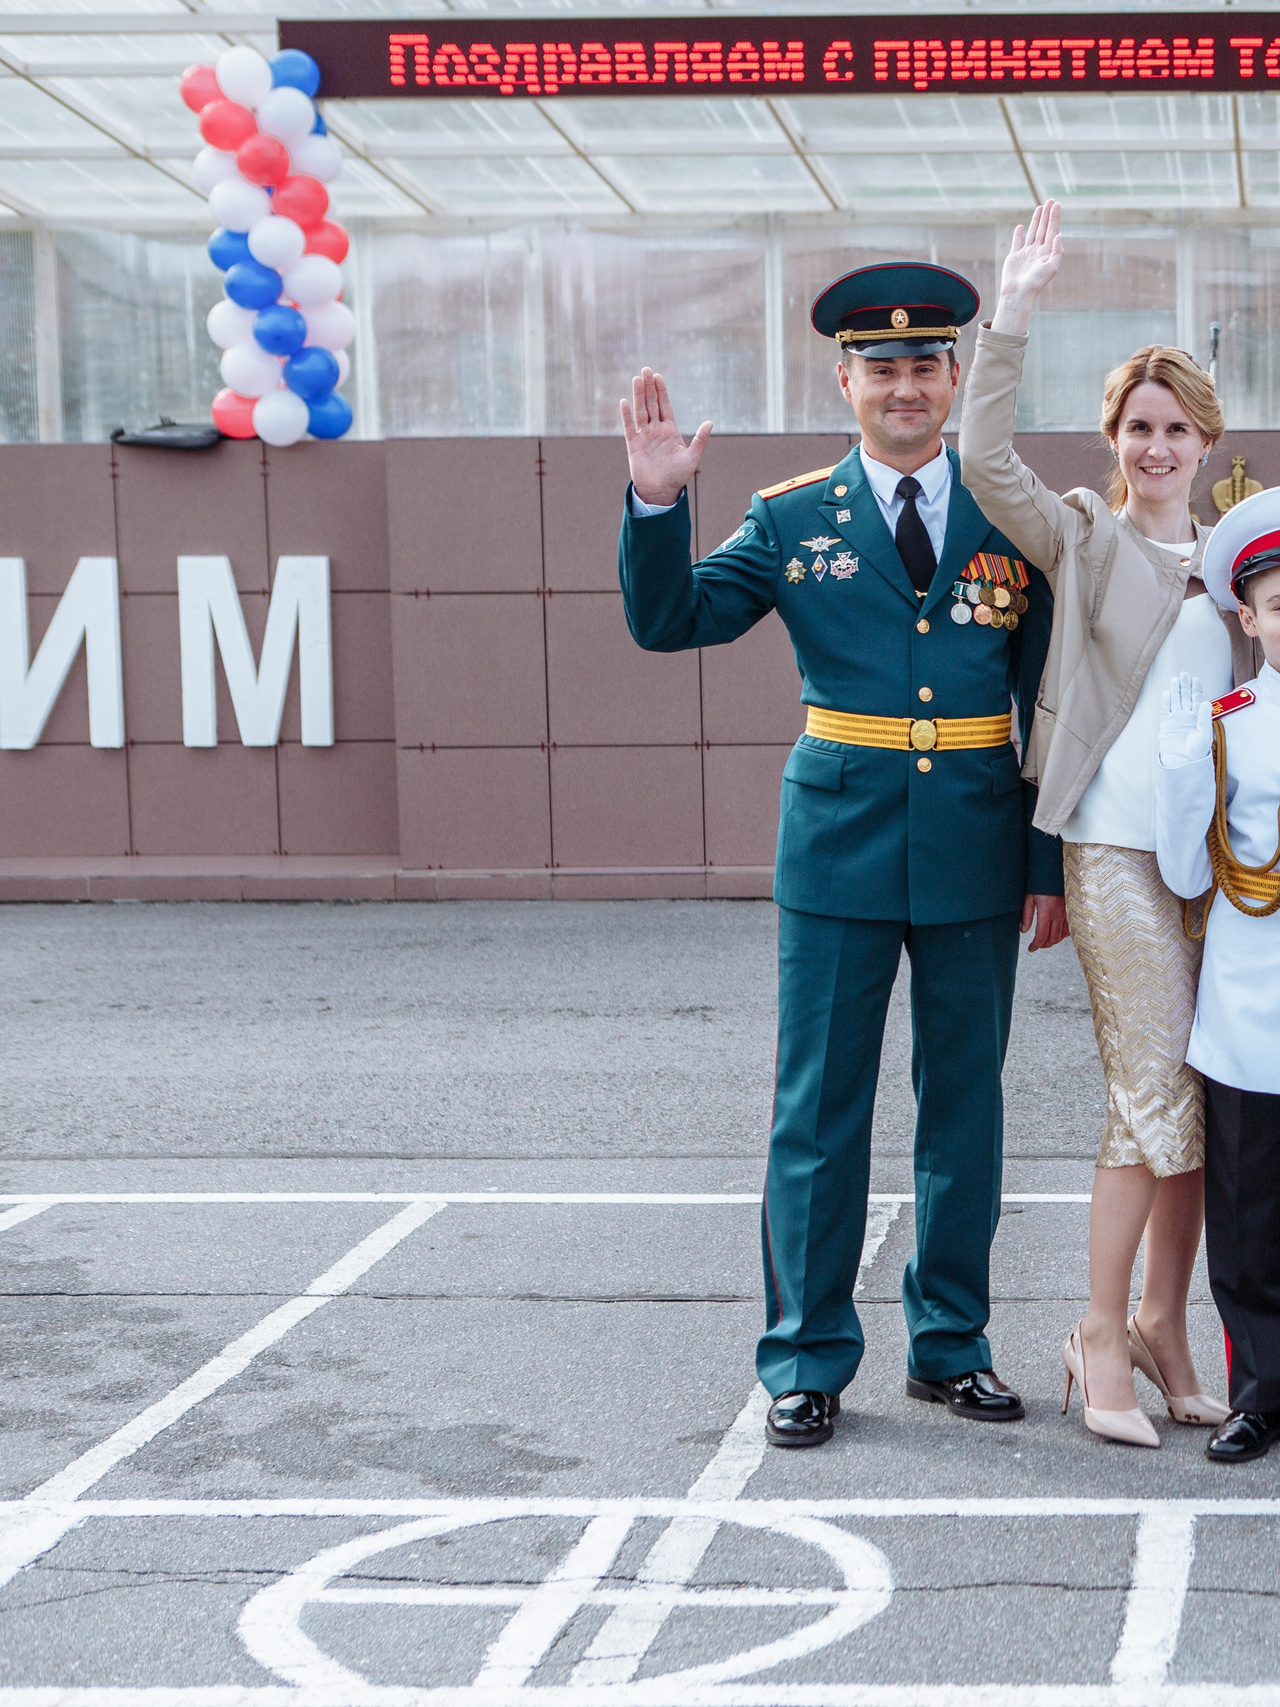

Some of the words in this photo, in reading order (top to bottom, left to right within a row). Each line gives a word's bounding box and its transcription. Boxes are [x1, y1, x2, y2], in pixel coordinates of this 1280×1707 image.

[388, 34, 805, 94] Поздравляем
[822, 40, 855, 82] с
[873, 38, 1214, 90] принятием
